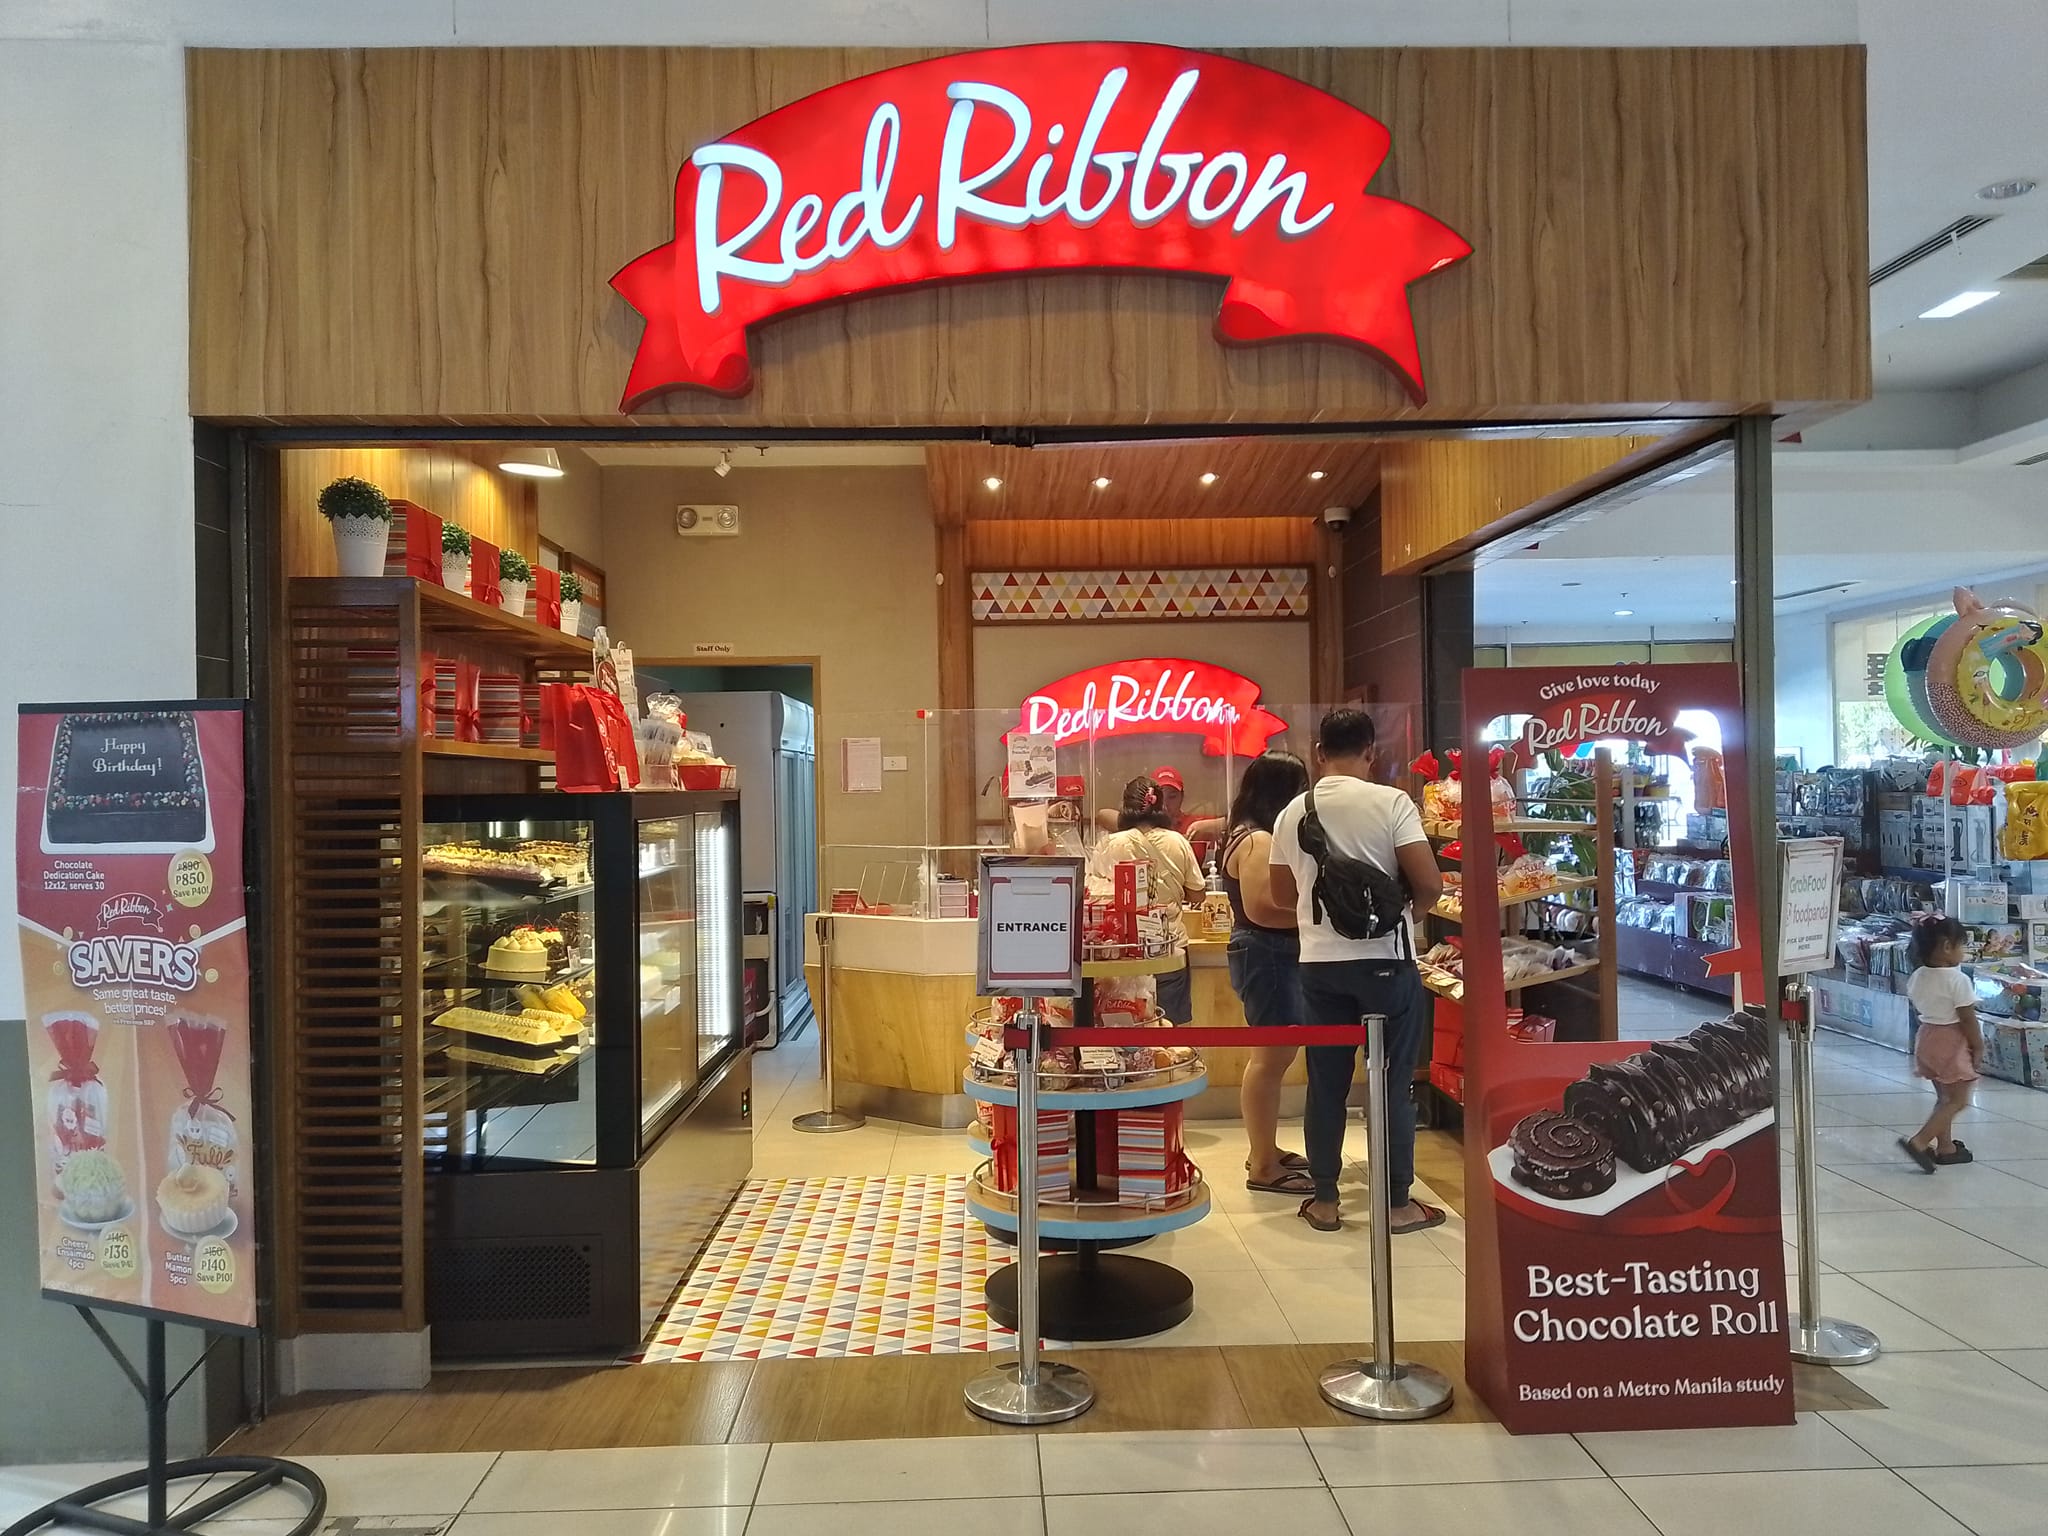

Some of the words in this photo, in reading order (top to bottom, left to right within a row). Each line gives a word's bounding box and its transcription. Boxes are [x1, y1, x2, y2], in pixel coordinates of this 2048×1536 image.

[692, 102, 923, 314] Red
[938, 67, 1335, 249] Ribbon
[714, 645, 731, 653] Only
[1539, 681, 1576, 701] Give
[1576, 674, 1610, 691] love
[1613, 673, 1661, 695] today
[1108, 669, 1241, 730] Ribbon
[1527, 707, 1577, 756] Red
[1579, 699, 1668, 739] Ribbon
[100, 737, 146, 755] Happy
[92, 757, 162, 777] Birthday!
[54, 860, 93, 869] Chocolate
[43, 870, 84, 880] Dedication
[85, 870, 104, 880] Cake
[175, 872, 205, 885] P850
[44, 881, 68, 891] 12x12,
[69, 883, 93, 891] serves
[94, 881, 104, 891] 30
[173, 888, 190, 898] Save
[191, 886, 209, 896] P40!
[103, 902, 121, 921] Red
[120, 897, 151, 915] Ribbon
[996, 921, 1068, 933] ENTRANCE
[70, 939, 197, 986] SAVERS
[93, 988, 121, 1001] Same
[122, 989, 149, 1001] great
[150, 989, 178, 1005] taste,
[105, 1002, 132, 1014] better
[134, 1003, 167, 1016] prices!
[62, 1237, 89, 1250] Cheesy
[56, 1247, 95, 1261] Ensaimada
[104, 1245, 129, 1259] P136
[166, 1252, 191, 1264] Butter
[68, 1258, 85, 1270] 4pcs
[103, 1261, 120, 1269] Save
[165, 1262, 192, 1275] Mamon
[201, 1259, 226, 1271] P140
[170, 1273, 188, 1286] 5pcs
[197, 1273, 215, 1282] Save
[216, 1272, 233, 1283] P10!
[1527, 1260, 1760, 1298] Best-Tasting
[1513, 1304, 1700, 1343] Chocolate
[1711, 1301, 1779, 1336] Roll
[1519, 1382, 1572, 1401] Based
[1576, 1386, 1599, 1399] on
[1603, 1387, 1613, 1398] a
[1617, 1379, 1669, 1398] Metro
[1674, 1376, 1732, 1396] Manila
[1736, 1374, 1785, 1396] study
